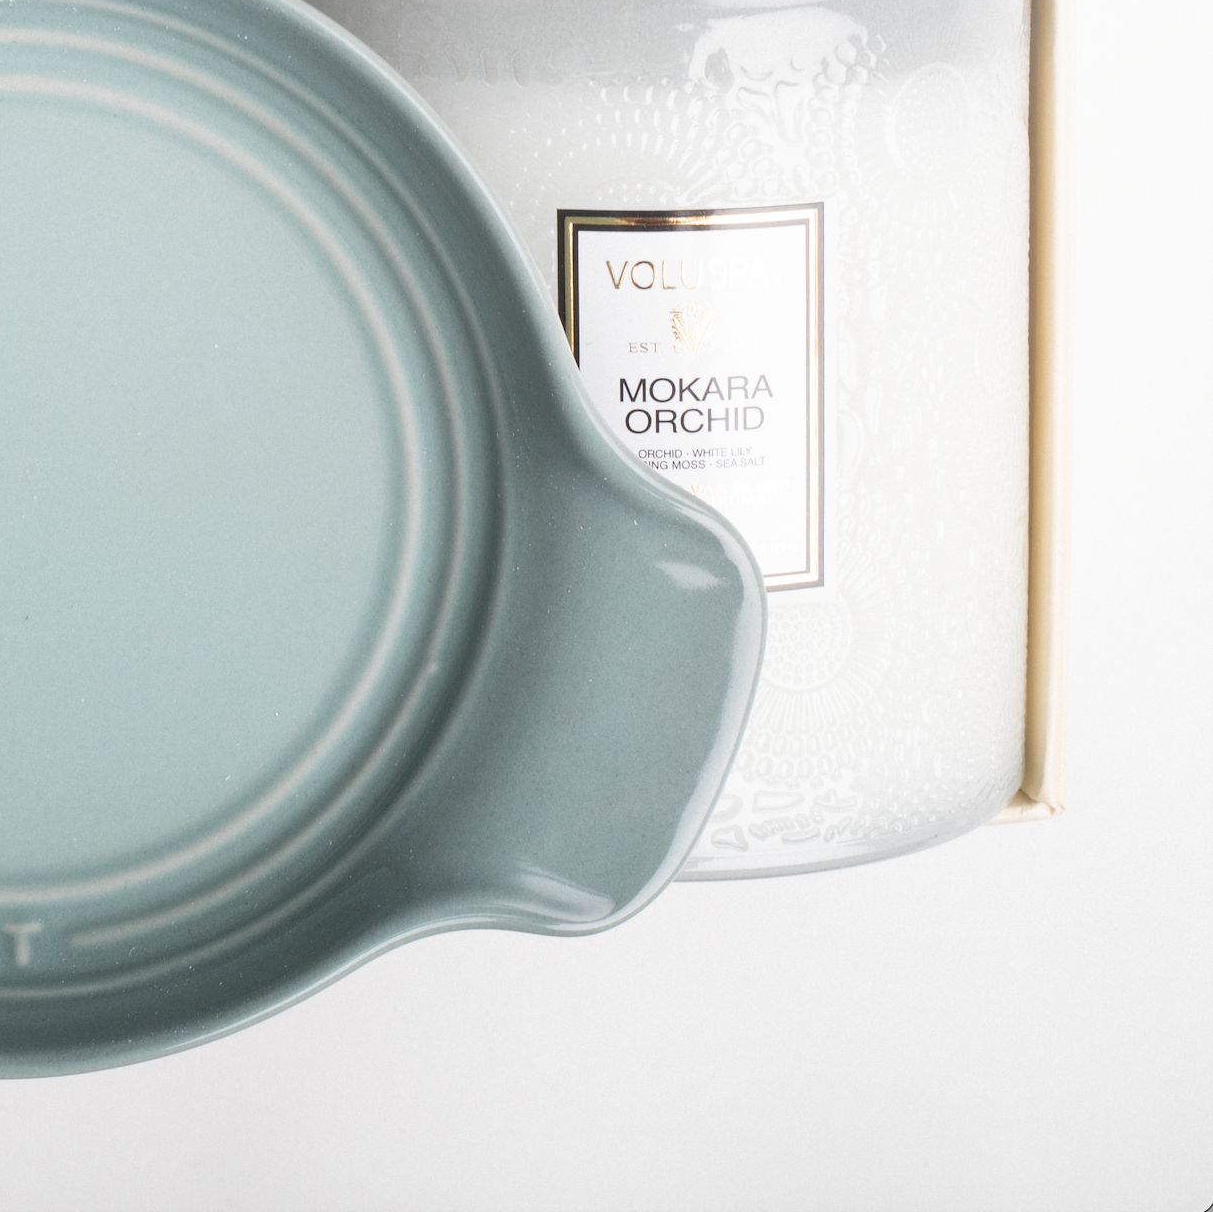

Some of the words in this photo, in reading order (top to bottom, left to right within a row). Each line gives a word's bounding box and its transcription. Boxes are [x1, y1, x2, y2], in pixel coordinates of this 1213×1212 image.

[618, 374, 774, 404] MOKARA
[624, 405, 765, 435] ORCHID
[638, 448, 683, 459] ORCHID
[692, 447, 728, 458] WHITE
[730, 446, 753, 457] LILY
[672, 459, 706, 470] MOSS
[715, 458, 738, 469] SEA
[739, 456, 766, 467] SALT
